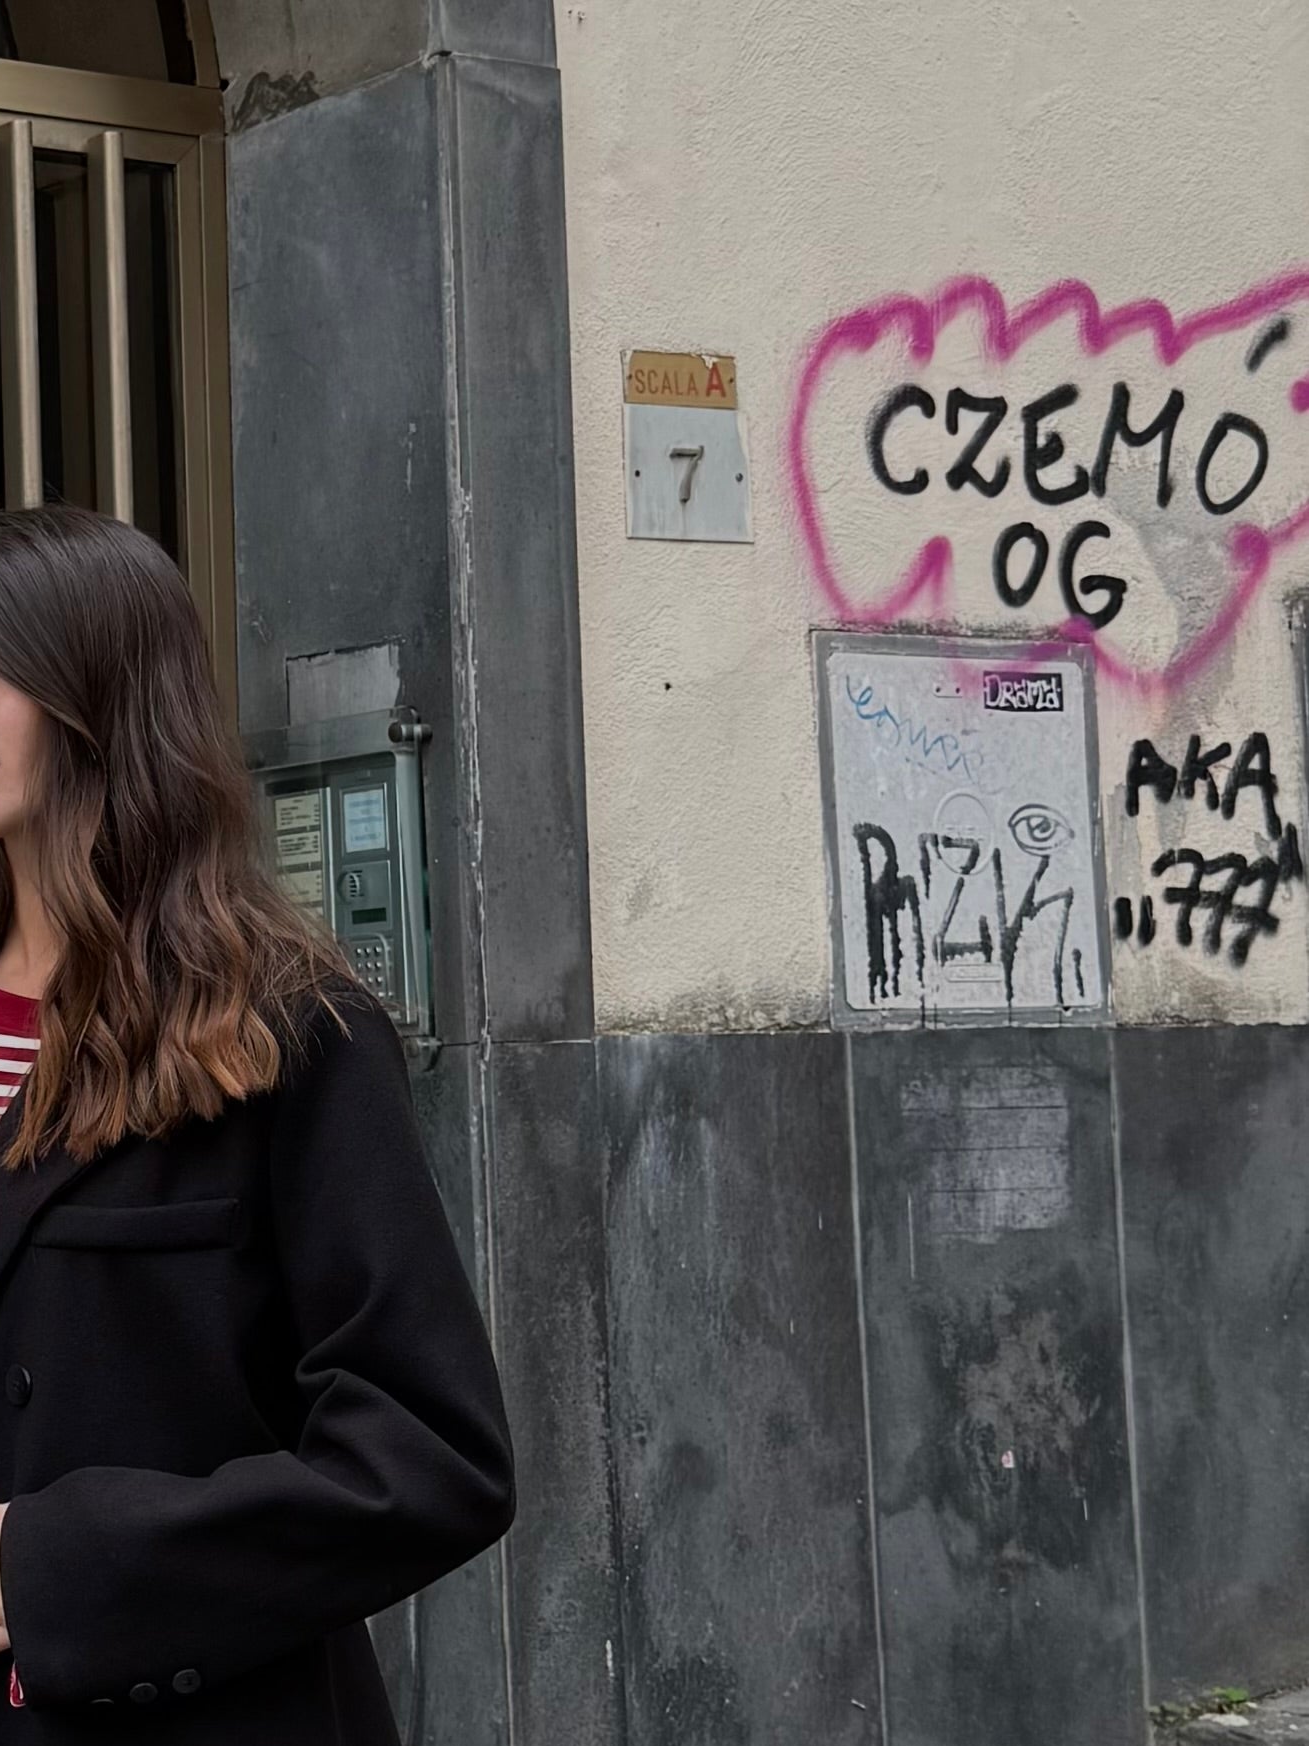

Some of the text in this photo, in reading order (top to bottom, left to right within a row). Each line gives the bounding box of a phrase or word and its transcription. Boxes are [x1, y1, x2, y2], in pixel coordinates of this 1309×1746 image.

[634, 361, 726, 397] SCALA A
[669, 445, 704, 503] 7
[993, 521, 1126, 632] OG
[1126, 732, 1282, 839] AKA
